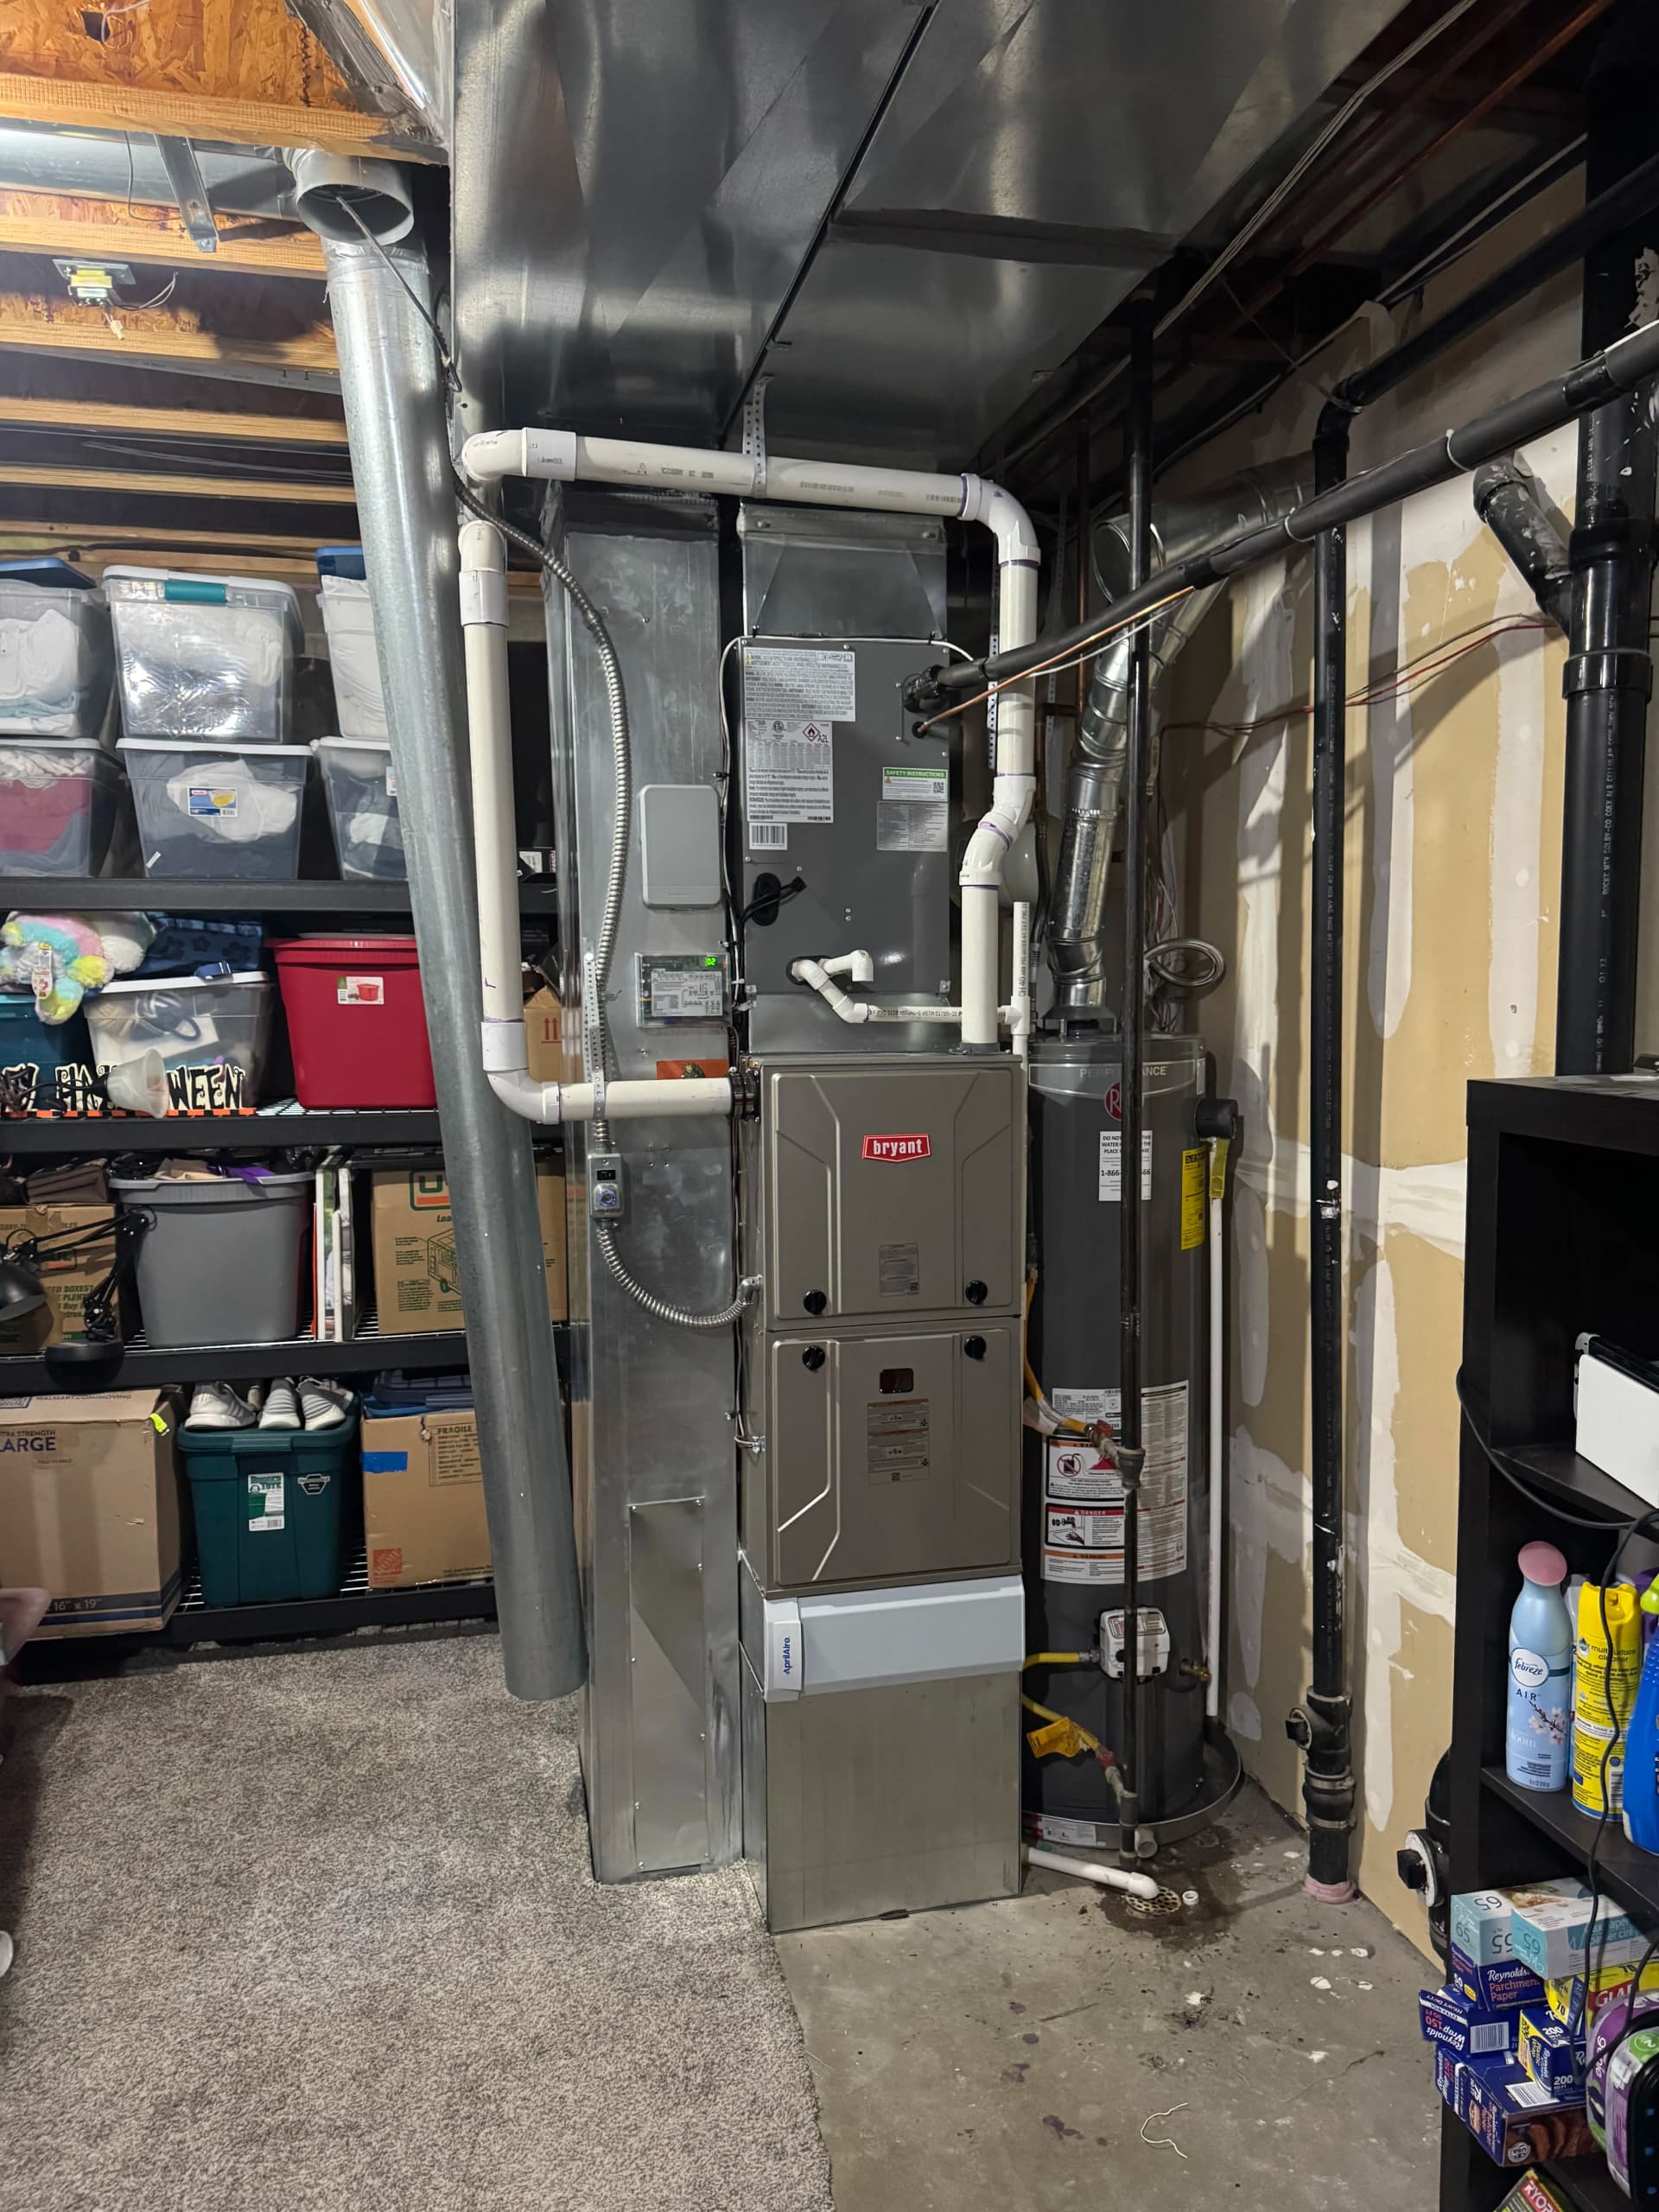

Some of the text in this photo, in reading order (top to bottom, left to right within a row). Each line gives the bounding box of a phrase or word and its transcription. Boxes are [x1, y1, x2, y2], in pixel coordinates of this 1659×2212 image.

[817, 734, 830, 743] A2L
[873, 1139, 923, 1156] bryant
[16, 1429, 56, 1438] STRENGTH
[436, 1424, 473, 1434] FRAGILE
[0, 1436, 56, 1452] ARGE
[782, 1637, 793, 1675] AprilAire
[1598, 1654, 1629, 1662] claner
[1514, 1657, 1544, 1676] febreze
[1486, 1967, 1528, 1982] Reynolds
[1488, 1979, 1543, 1993] Parchmen
[1425, 1994, 1444, 2006] DUTY
[1490, 1990, 1517, 2003] Paper
[1443, 2002, 1464, 2014] HEAVY
[1556, 2000, 1566, 2016] 70
[1425, 2016, 1466, 2044] Wrap 150
[1541, 2025, 1564, 2036] 200
[1426, 2027, 1465, 2051] Reynolds
[1554, 2075, 1573, 2086] 200
